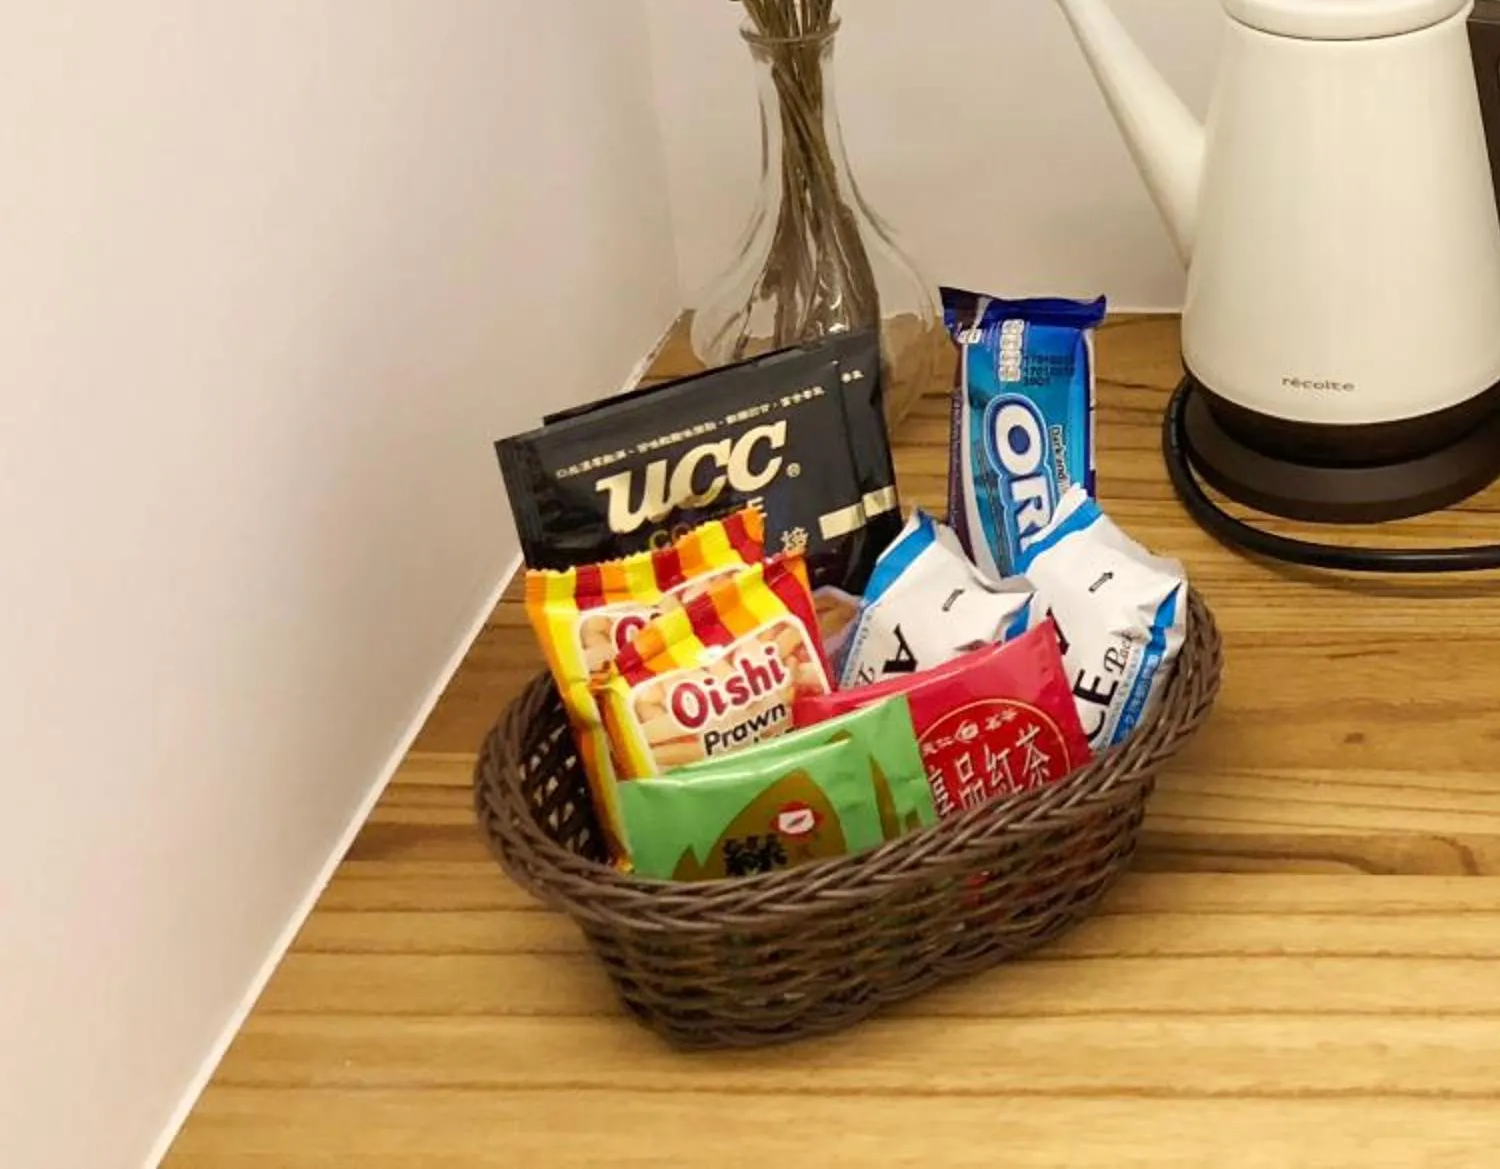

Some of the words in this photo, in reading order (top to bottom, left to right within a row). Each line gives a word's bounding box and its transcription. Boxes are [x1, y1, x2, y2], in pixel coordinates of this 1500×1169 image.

[994, 402, 1052, 554] OR
[671, 646, 785, 728] Oishi
[703, 703, 786, 756] Prawn
